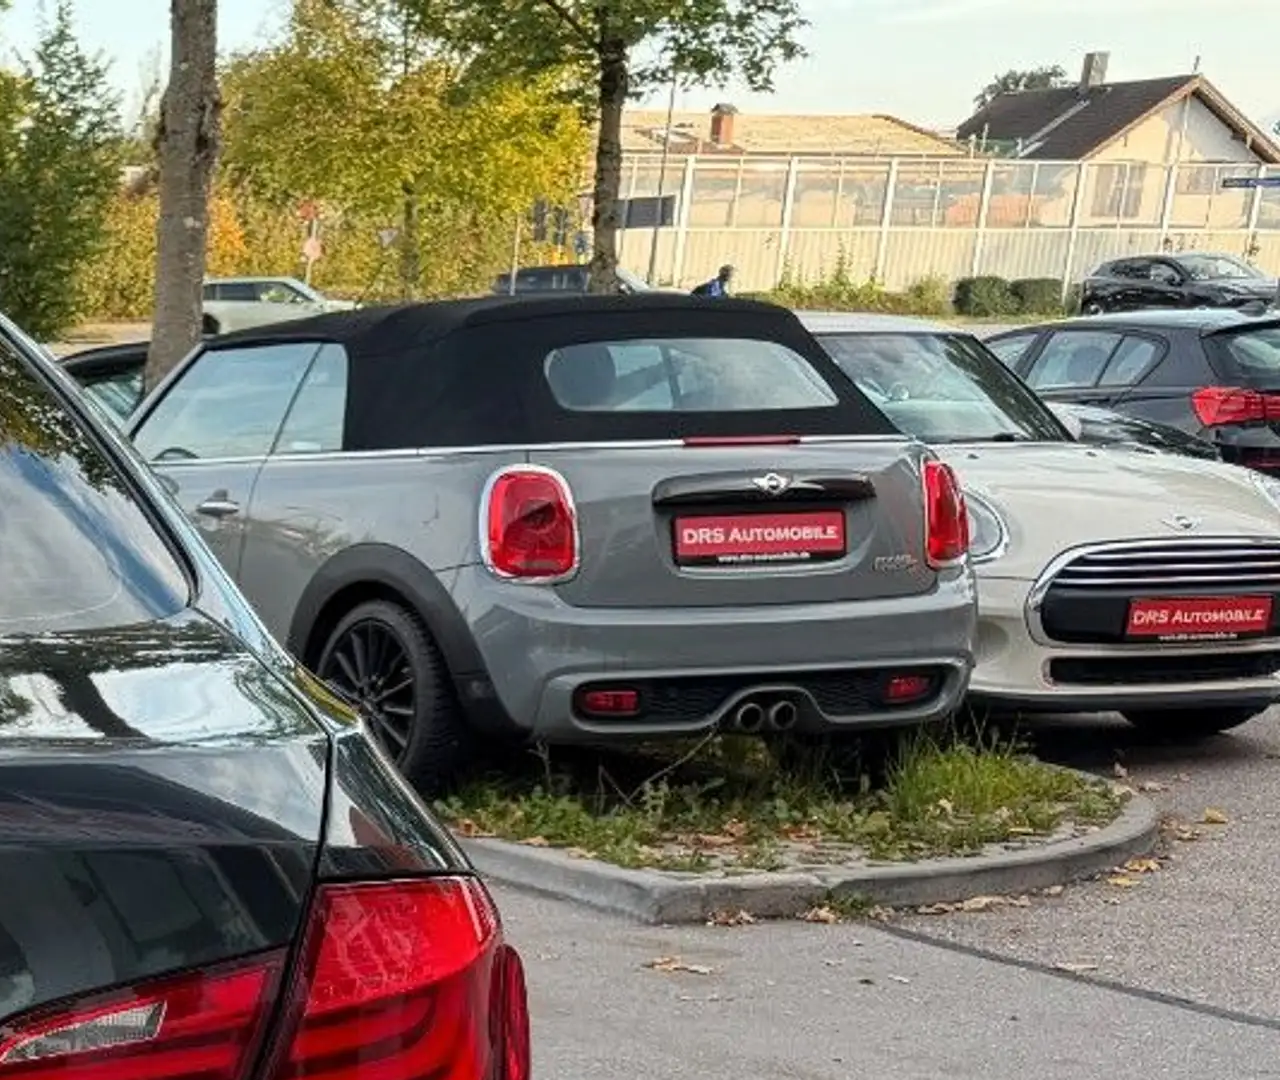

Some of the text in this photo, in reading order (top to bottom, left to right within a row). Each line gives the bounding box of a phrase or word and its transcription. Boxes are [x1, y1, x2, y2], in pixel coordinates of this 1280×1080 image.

[682, 525, 838, 545] DRS AUTOMOBILE
[1133, 609, 1169, 625] DRS
